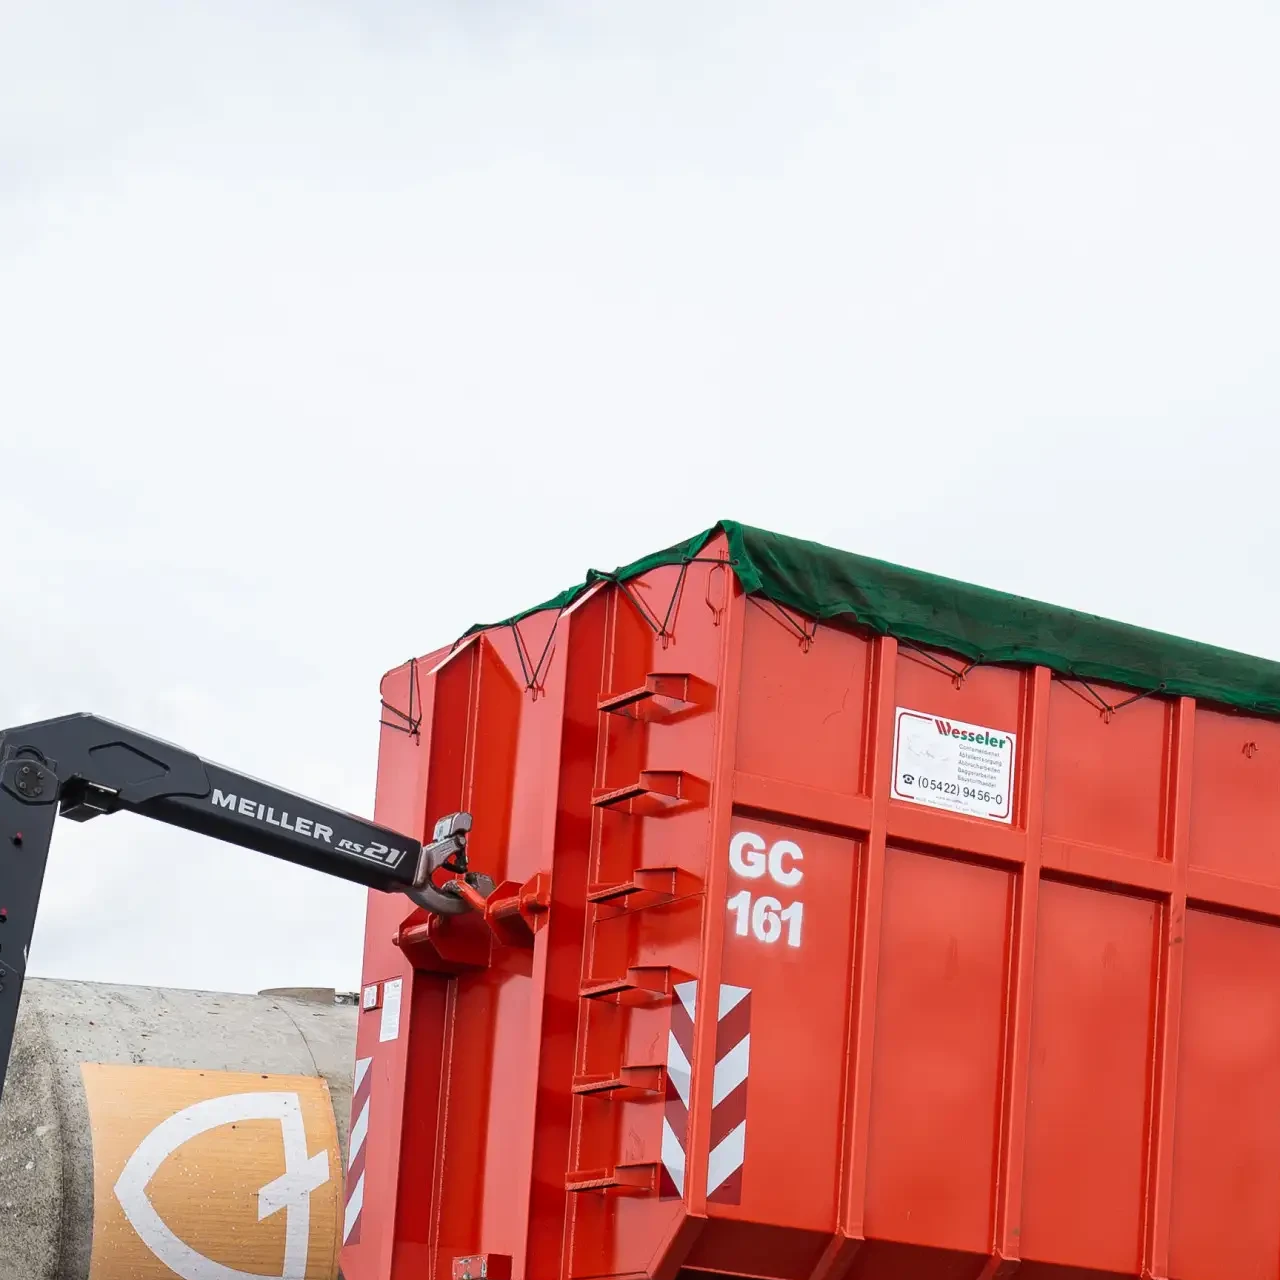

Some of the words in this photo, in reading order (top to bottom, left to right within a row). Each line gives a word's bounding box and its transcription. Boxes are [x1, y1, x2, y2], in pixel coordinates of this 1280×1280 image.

[935, 719, 1006, 749] Wesseler
[211, 788, 334, 843] MEILLER
[729, 831, 804, 888] GC
[727, 890, 804, 948] 161
